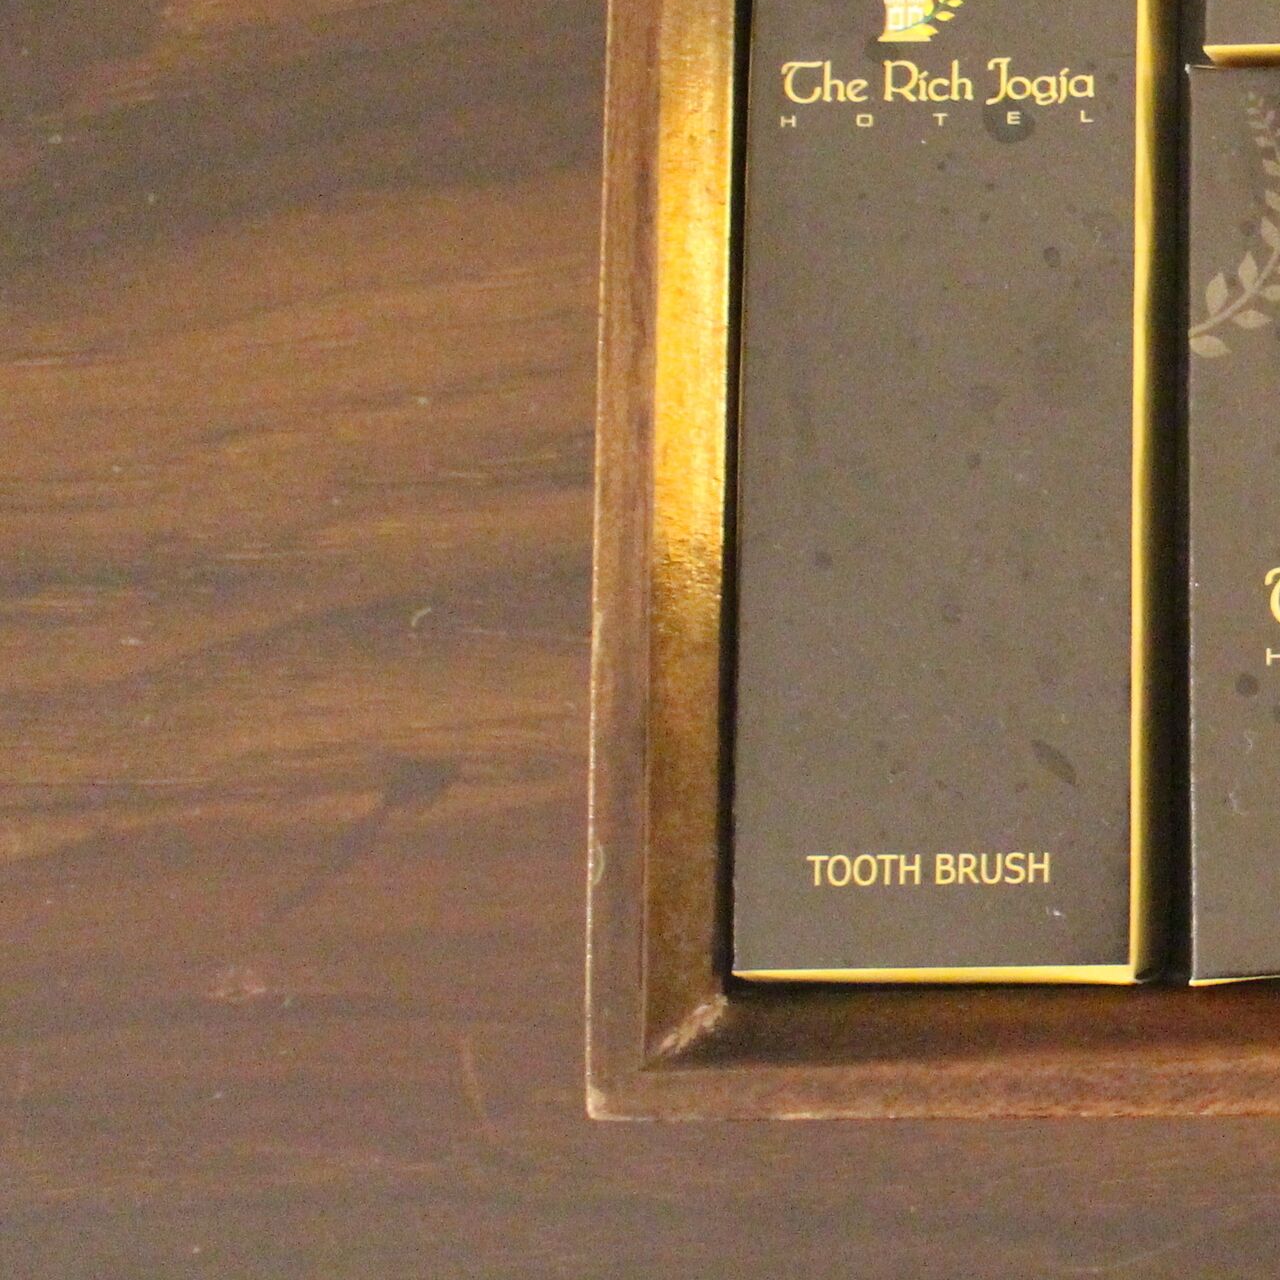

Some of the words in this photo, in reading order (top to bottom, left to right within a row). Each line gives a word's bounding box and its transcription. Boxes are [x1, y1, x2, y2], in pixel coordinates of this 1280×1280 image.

[781, 59, 869, 104] The
[883, 58, 974, 103] Rich
[985, 56, 1096, 106] Jogja
[805, 853, 922, 888] TOOTH
[935, 851, 1051, 886] BRUSH
